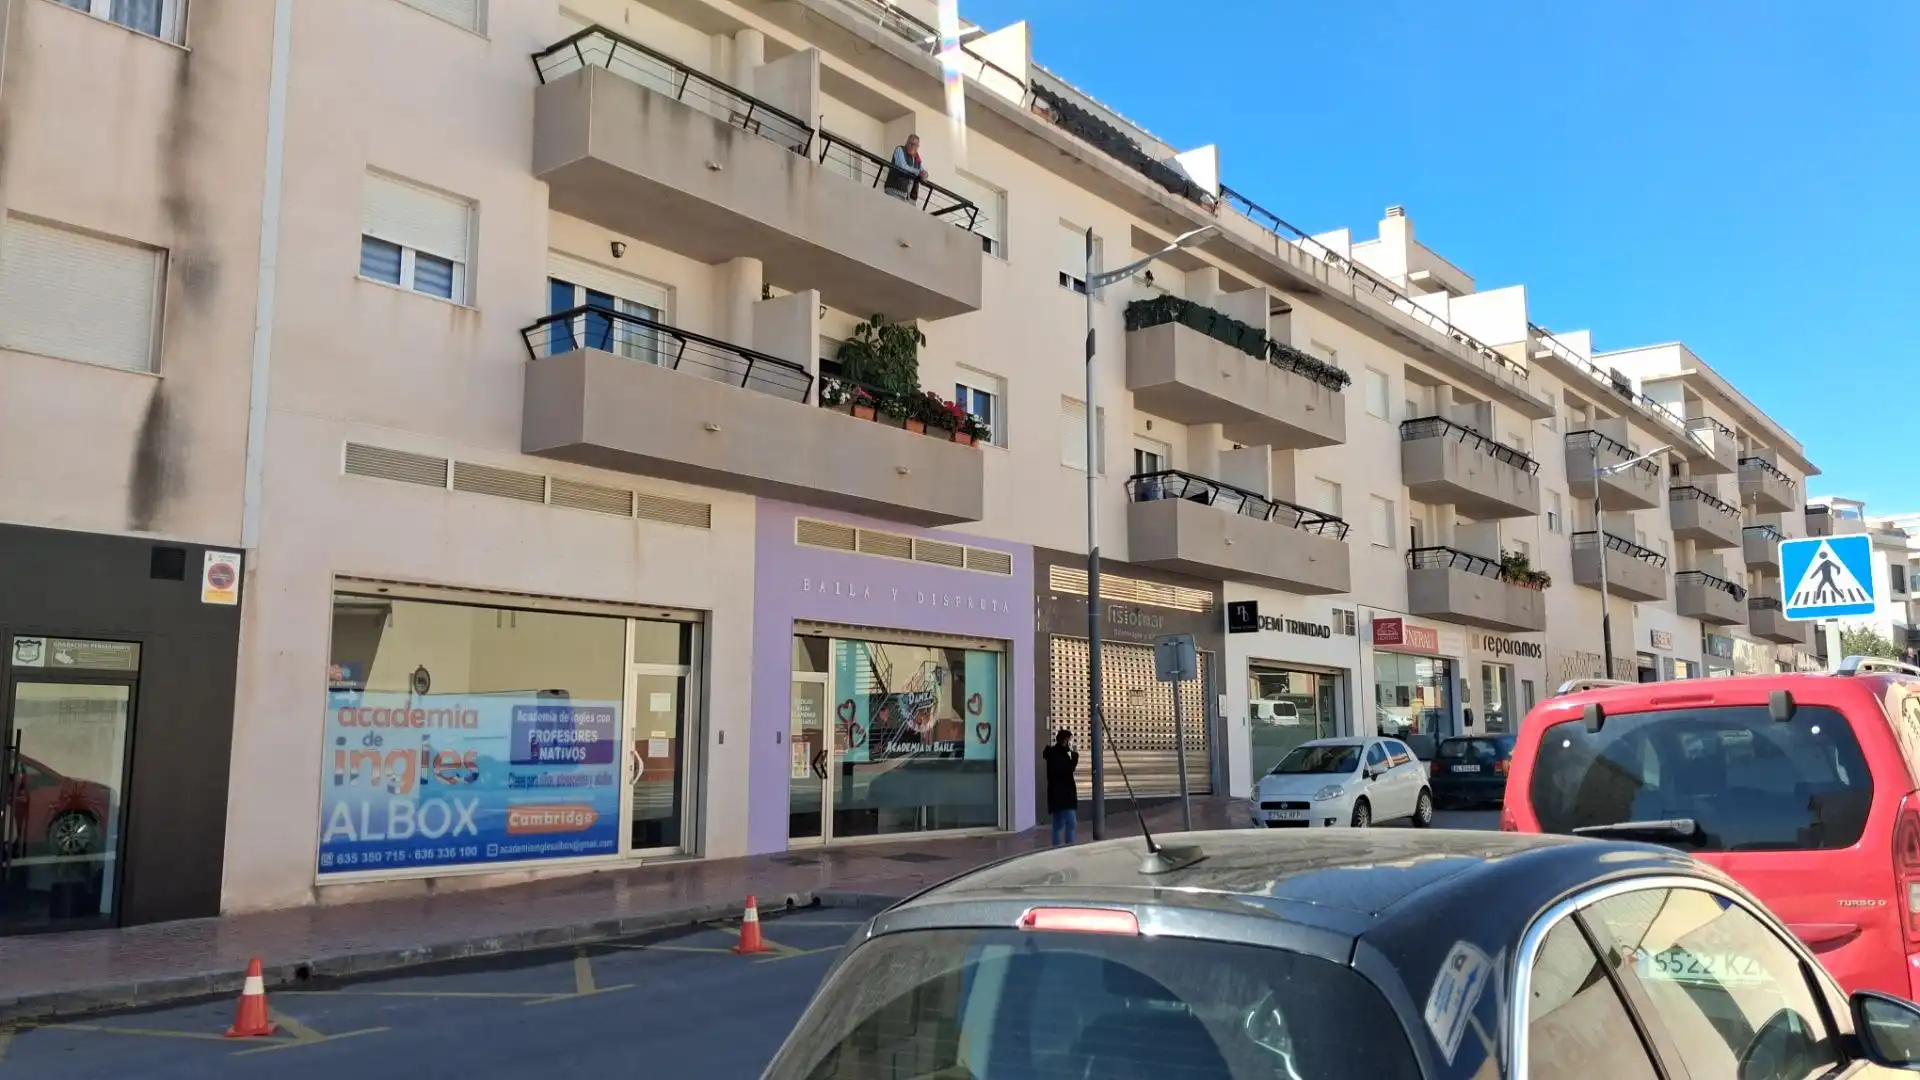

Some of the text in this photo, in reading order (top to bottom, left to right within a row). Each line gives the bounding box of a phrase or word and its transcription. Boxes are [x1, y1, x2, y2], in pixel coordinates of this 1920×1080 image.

[803, 578, 1009, 613] BAILA Y DISFRUTA
[1285, 618, 1331, 639] TRINIDAD
[1404, 628, 1435, 649] ENERALI
[1483, 635, 1542, 659] reparamos
[337, 703, 479, 729] academia
[516, 709, 557, 723] Academia
[559, 710, 569, 723] de
[596, 713, 611, 723] con
[362, 731, 383, 746] de
[528, 729, 598, 743] PROFESORES
[539, 747, 587, 761] NATIVOS
[322, 796, 479, 844] ALBOX
[508, 811, 593, 827] Cambridge
[336, 854, 357, 864] 635
[361, 852, 381, 862] 350
[386, 850, 405, 861] 715
[460, 846, 477, 856] 100
[1837, 899, 1876, 908] TURBO
[1655, 951, 1715, 974] 5522
